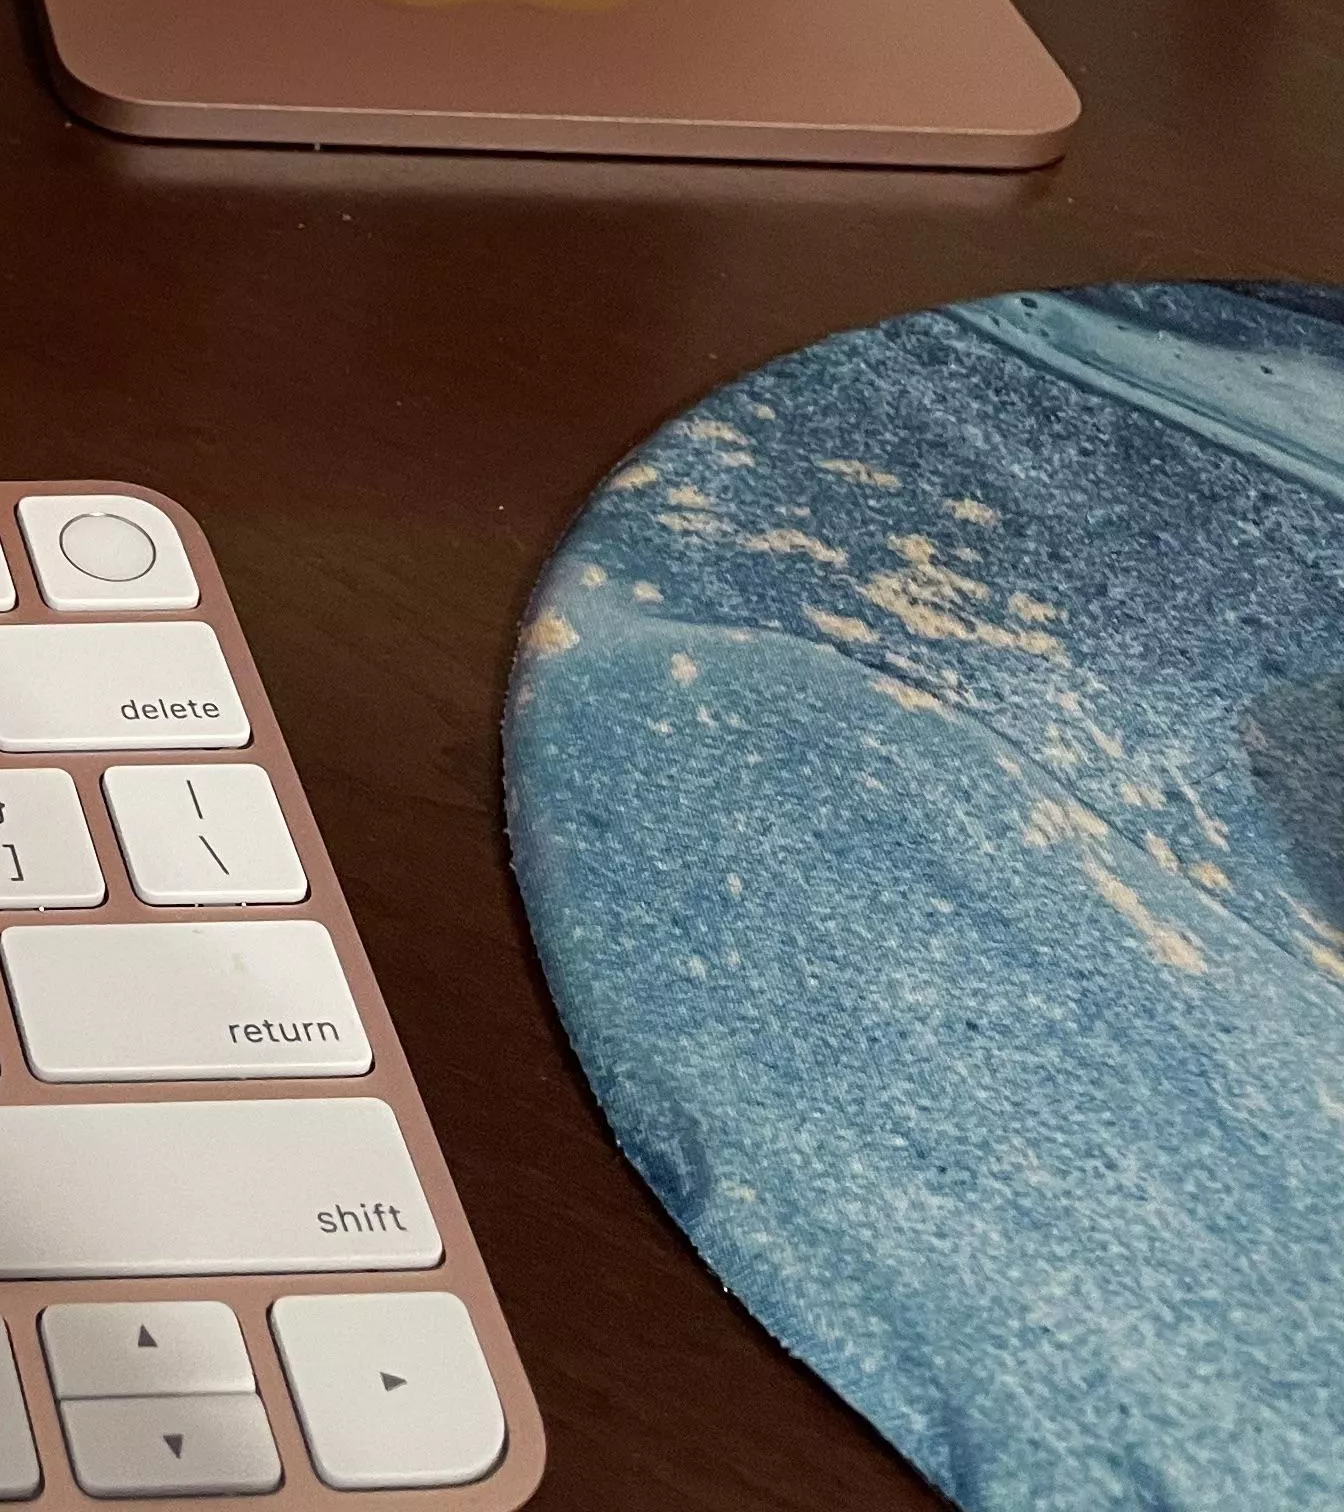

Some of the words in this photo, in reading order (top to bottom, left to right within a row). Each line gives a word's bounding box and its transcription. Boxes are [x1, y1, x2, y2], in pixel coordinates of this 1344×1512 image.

[120, 698, 220, 721] delete
[1, 843, 24, 882] ]
[228, 1019, 340, 1044] return
[317, 1202, 407, 1234] shift
